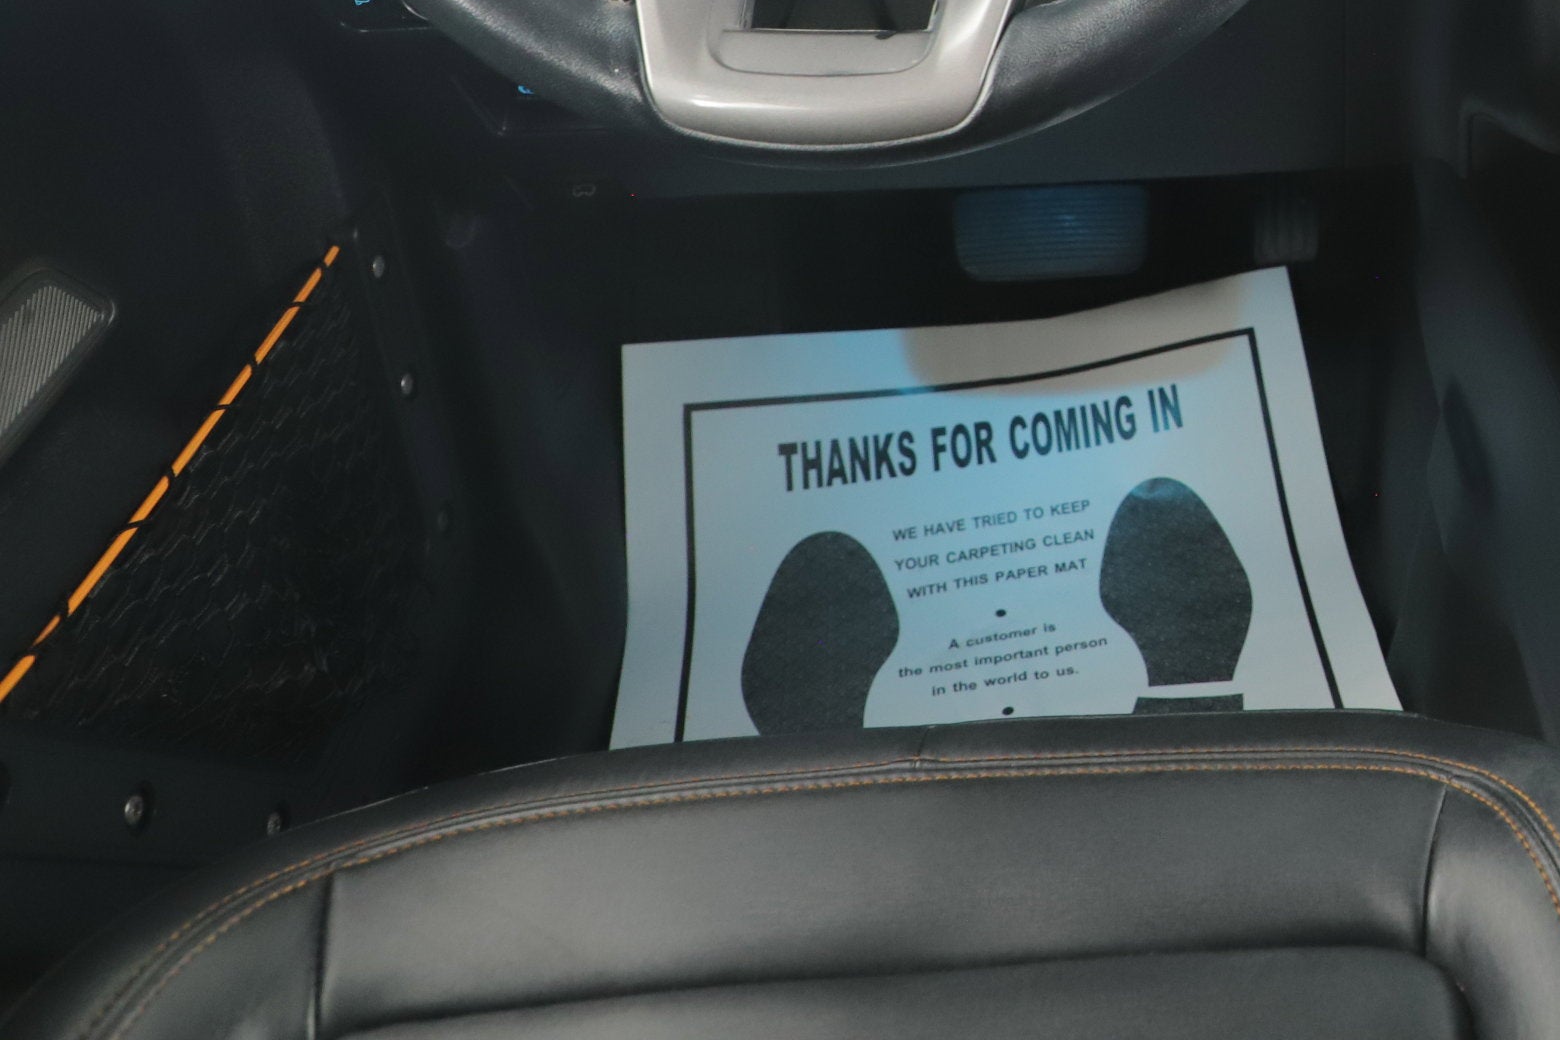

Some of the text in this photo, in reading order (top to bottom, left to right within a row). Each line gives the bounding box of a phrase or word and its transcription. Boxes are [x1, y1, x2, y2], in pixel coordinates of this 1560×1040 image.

[778, 383, 1184, 492] THANKS FOR COMING IN
[892, 499, 1091, 542] WE HAVE TRIED TO KEEP
[894, 529, 1095, 571] YOUR CARPETING CLEAN
[906, 557, 1088, 599] WITH THIS PAPER MAT
[898, 637, 1108, 678] the most important person
[948, 623, 1056, 650] A customer is
[931, 666, 1079, 697] in the world to us.
